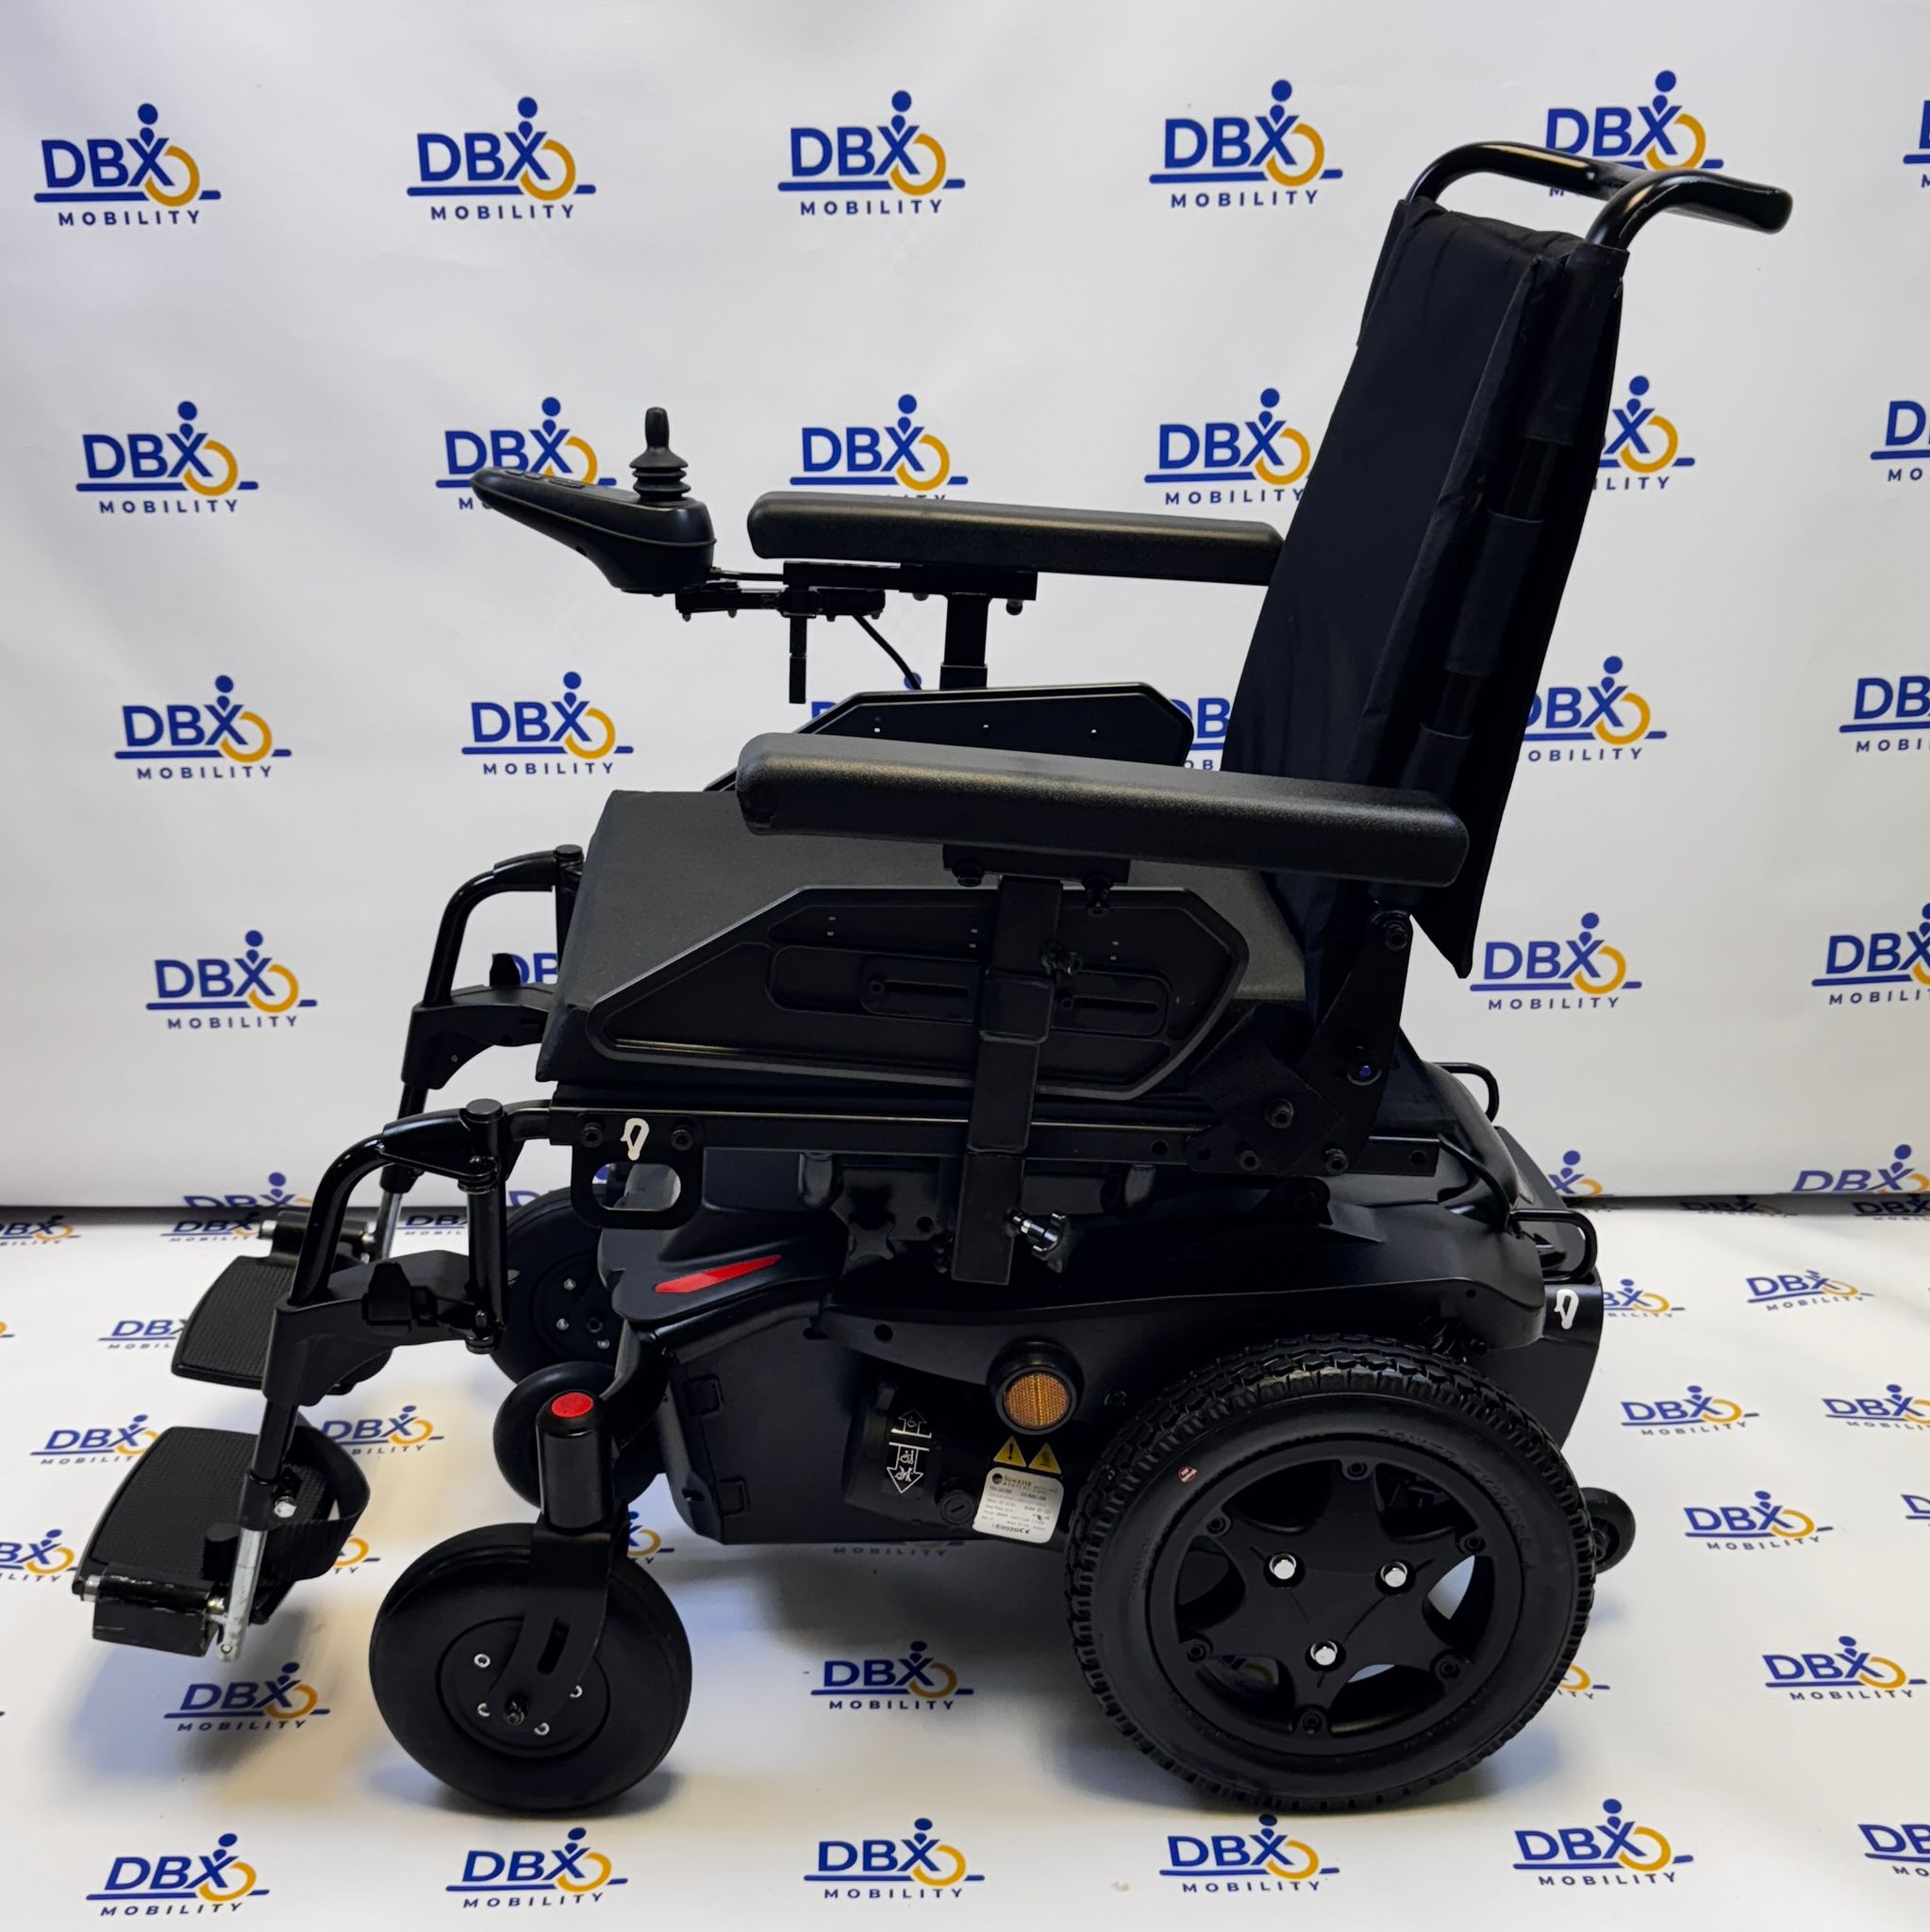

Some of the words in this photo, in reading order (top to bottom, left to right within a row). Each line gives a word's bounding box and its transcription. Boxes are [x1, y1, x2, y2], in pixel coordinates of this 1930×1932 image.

[1546, 106, 1682, 156] DBX
[790, 125, 920, 177] DBX
[1164, 115, 1299, 169] DBX
[42, 138, 175, 188] DBX
[417, 131, 551, 182] DBX
[800, 199, 942, 216] MOBILITY
[1171, 191, 1319, 208] MOBILITY
[58, 209, 200, 226] MOBILITY
[430, 205, 574, 221] MOBILITY
[82, 433, 212, 479] DBX
[445, 429, 573, 475] DBX
[802, 426, 924, 472] DBX
[1159, 421, 1286, 470] DBX
[99, 499, 238, 514] MOBILITY
[1165, 489, 1304, 505] MOBILITY
[1854, 676, 1930, 720] DB
[123, 703, 246, 747] DBX
[472, 700, 591, 742] DBX
[1528, 748, 1642, 761] OBILITY
[1855, 739, 1922, 752] MOBI
[137, 766, 272, 779] MOBILITY
[483, 762, 613, 775] MOBILITY
[1484, 940, 1604, 980] DBX
[155, 957, 275, 998] DBX
[1488, 997, 1619, 1009] MOBILITY
[1829, 990, 1930, 1005] MOBILI
[167, 1016, 297, 1028] MOBILITY
[1792, 1169, 1915, 1191] DBX
[406, 1214, 469, 1225] DB
[1746, 1275, 1840, 1296] DBX
[1604, 1291, 1652, 1306] BX
[1766, 1295, 1864, 1311] MOBILITY
[1621, 1396, 1716, 1421] DBX
[1822, 1397, 1925, 1416] DBX
[45, 1427, 147, 1449] DBX
[323, 1417, 418, 1440] DBX
[1641, 1421, 1746, 1435] MOBILITY
[351, 1445, 424, 1455] BILITY
[1685, 1505, 1793, 1532] DBX
[0, 1542, 61, 1564] BX
[834, 1547, 946, 1556] MOBILITY
[1706, 1537, 1820, 1550] MOBILITY
[824, 1657, 934, 1689] DBX
[1763, 1653, 1884, 1680] DBX
[180, 1680, 301, 1711] DBX
[829, 1700, 955, 1710] MOBILITY
[1789, 1690, 1913, 1701] MOBILITY
[176, 1721, 307, 1732] MOBILITY
[1168, 1833, 1294, 1867] DBX
[1514, 1822, 1647, 1861] DBX
[1857, 1824, 1930, 1855] DB
[461, 1847, 590, 1883] DBX
[819, 1840, 941, 1873] DBX
[104, 1855, 239, 1890] DBX
[1539, 1872, 1676, 1886] MOBILITY
[824, 1888, 962, 1899] MOBILITY
[1182, 1881, 1320, 1893] MOBILITY
[100, 1902, 242, 1916] MOBILITY
[463, 1892, 603, 1907] MOBILITY
